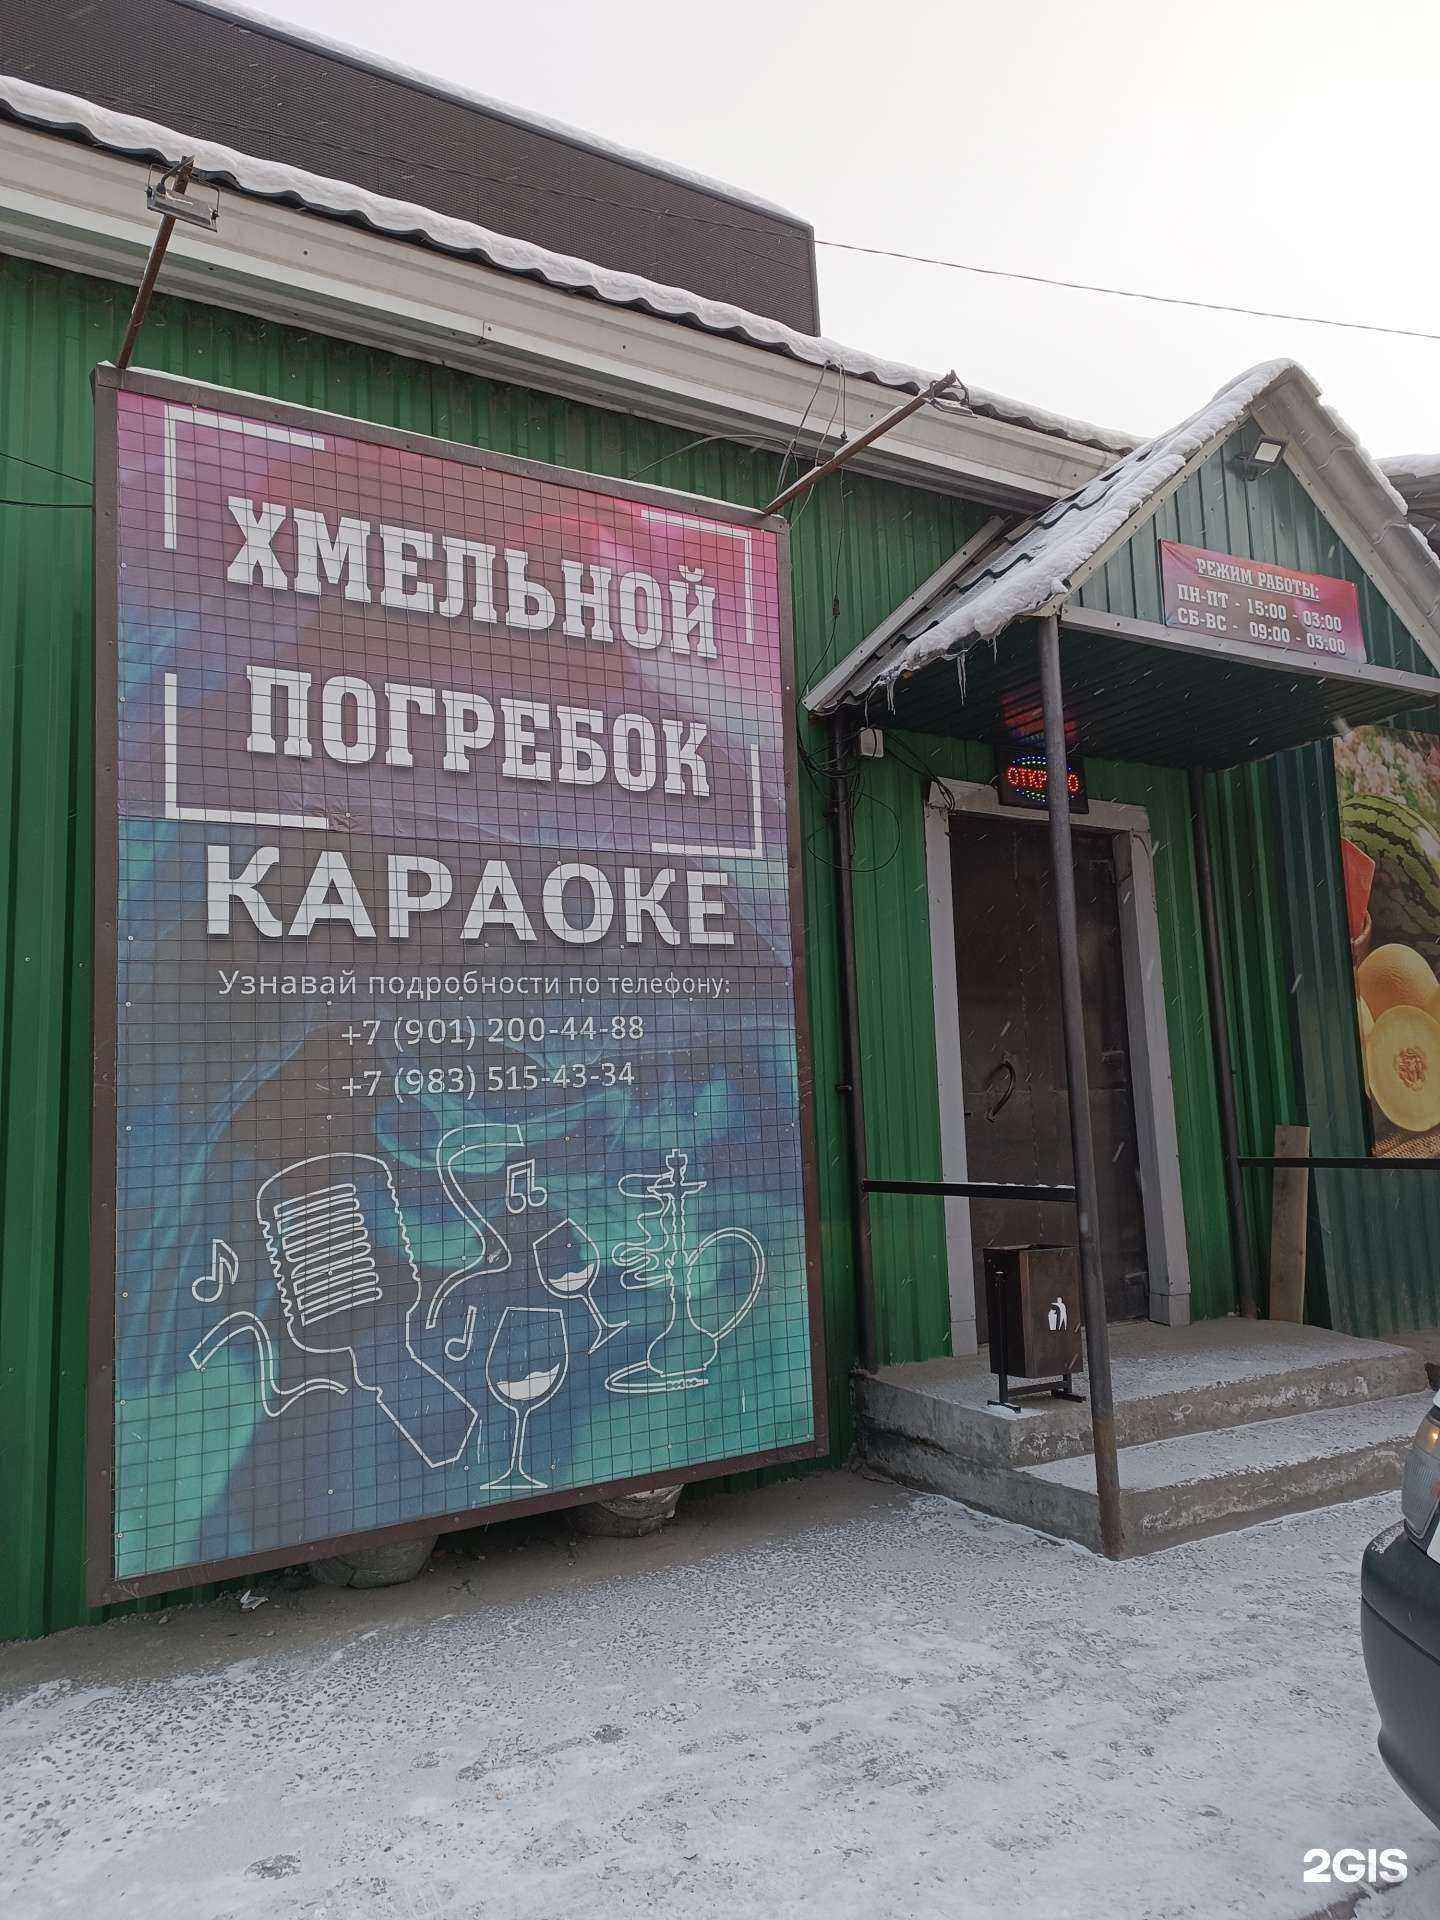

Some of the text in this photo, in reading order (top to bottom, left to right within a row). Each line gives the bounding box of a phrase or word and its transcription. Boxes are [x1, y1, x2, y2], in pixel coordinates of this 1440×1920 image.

[227, 496, 718, 659] ХМЕЛЬНОЙ
[1196, 558, 1320, 599] РЕЖИМ РАБОТЫ:
[1177, 584, 1228, 609] ПН-ПТ
[1248, 598, 1287, 621] 15:00
[1302, 610, 1342, 631] 03:00
[1177, 607, 1227, 631] СБ-ВС
[1249, 621, 1290, 643] 09:00
[1306, 632, 1346, 654] 03:00
[246, 665, 710, 798] ПОГРЕБОК
[1007, 767, 1079, 791] ОТКРО
[206, 844, 735, 946] КАРАОКЕ
[218, 969, 731, 1000] Узнавай подробности по телефону:
[341, 1016, 645, 1052] +7 (901) 200-44-88
[341, 1062, 635, 1103] +7 (983) 515-43-34
